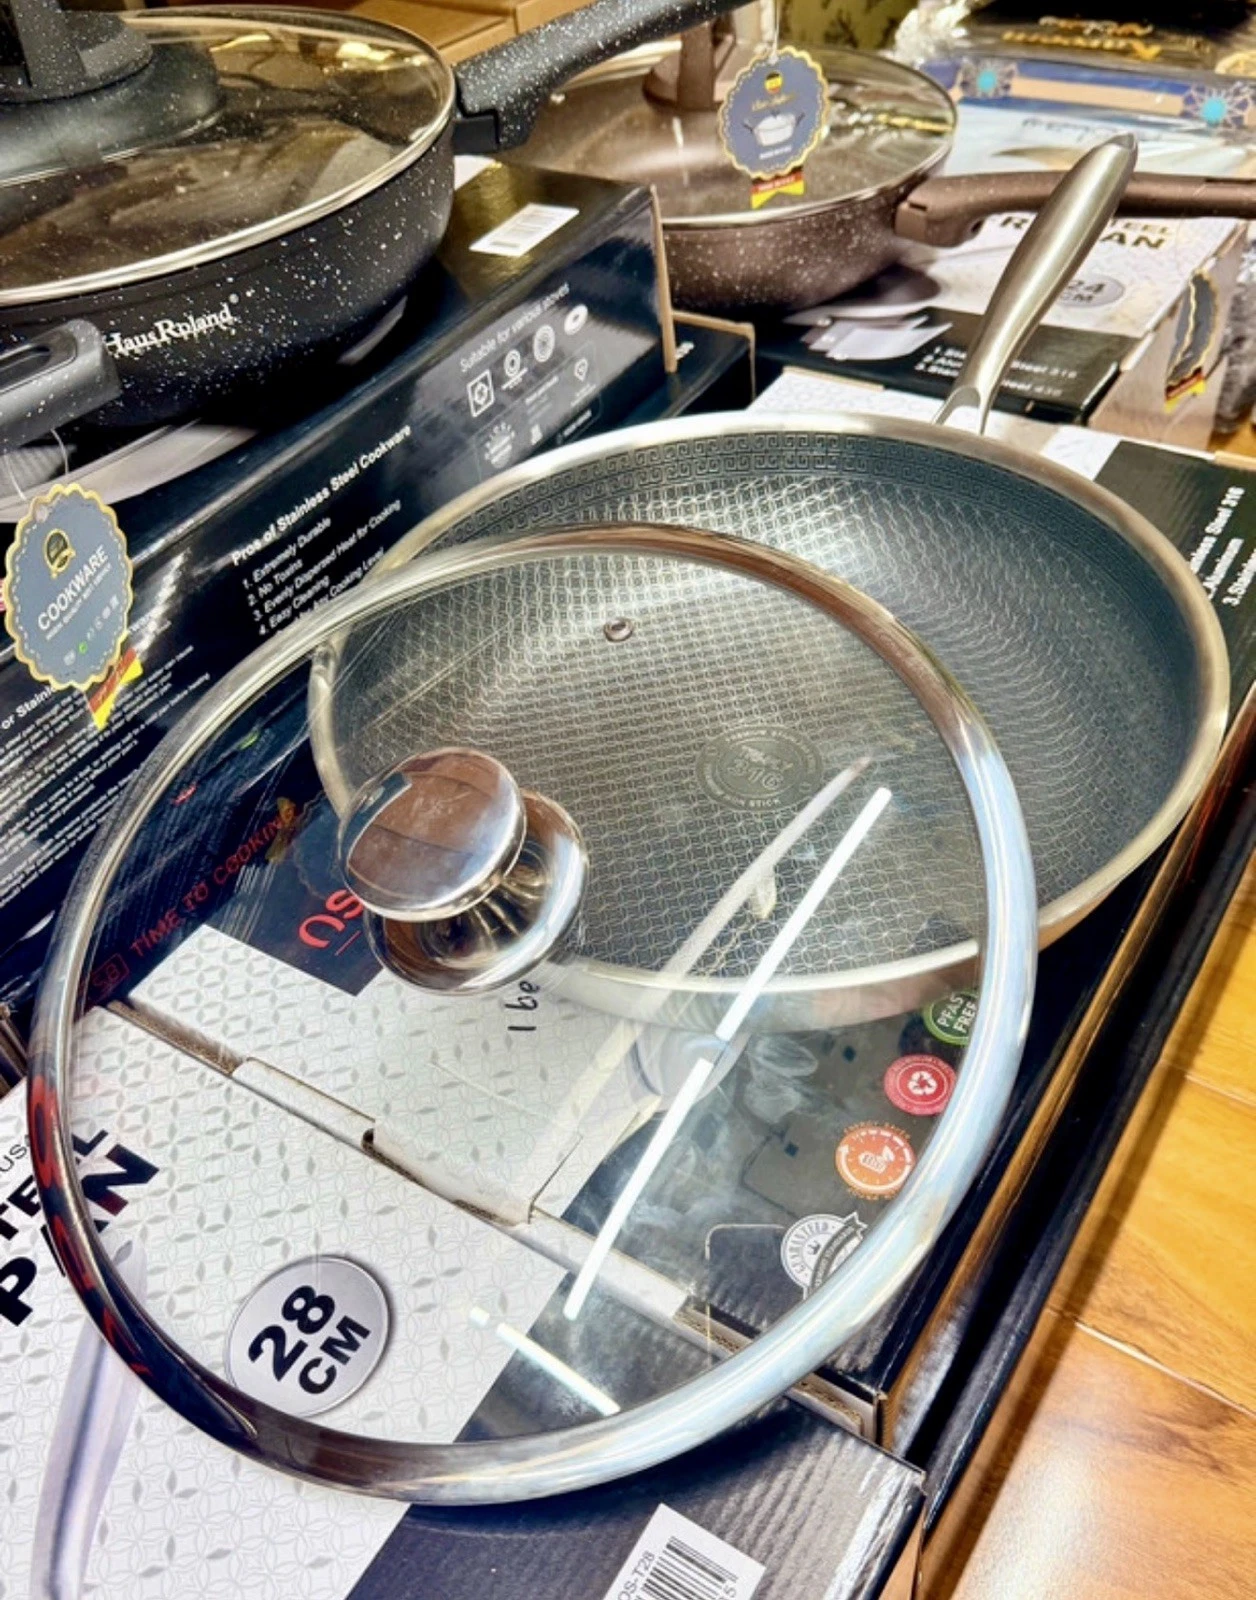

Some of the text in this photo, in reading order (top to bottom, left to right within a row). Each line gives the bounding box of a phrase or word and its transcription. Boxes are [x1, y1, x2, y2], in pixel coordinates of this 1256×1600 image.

[231, 425, 412, 566] Pros of Stainless Steel Cookware
[37, 544, 109, 631] COOKWARE
[252, 541, 298, 583] Extremely
[297, 516, 333, 549] Durable
[263, 582, 295, 613] Evenly
[368, 498, 402, 533] Cooking
[257, 581, 274, 599] No
[268, 603, 293, 629] Easy
[292, 574, 331, 610] Cleaning
[130, 908, 182, 957] TIME
[182, 880, 209, 913] TO
[936, 993, 964, 1028] PFAS
[247, 1284, 336, 1383] 28
[298, 1315, 371, 1395] CM
